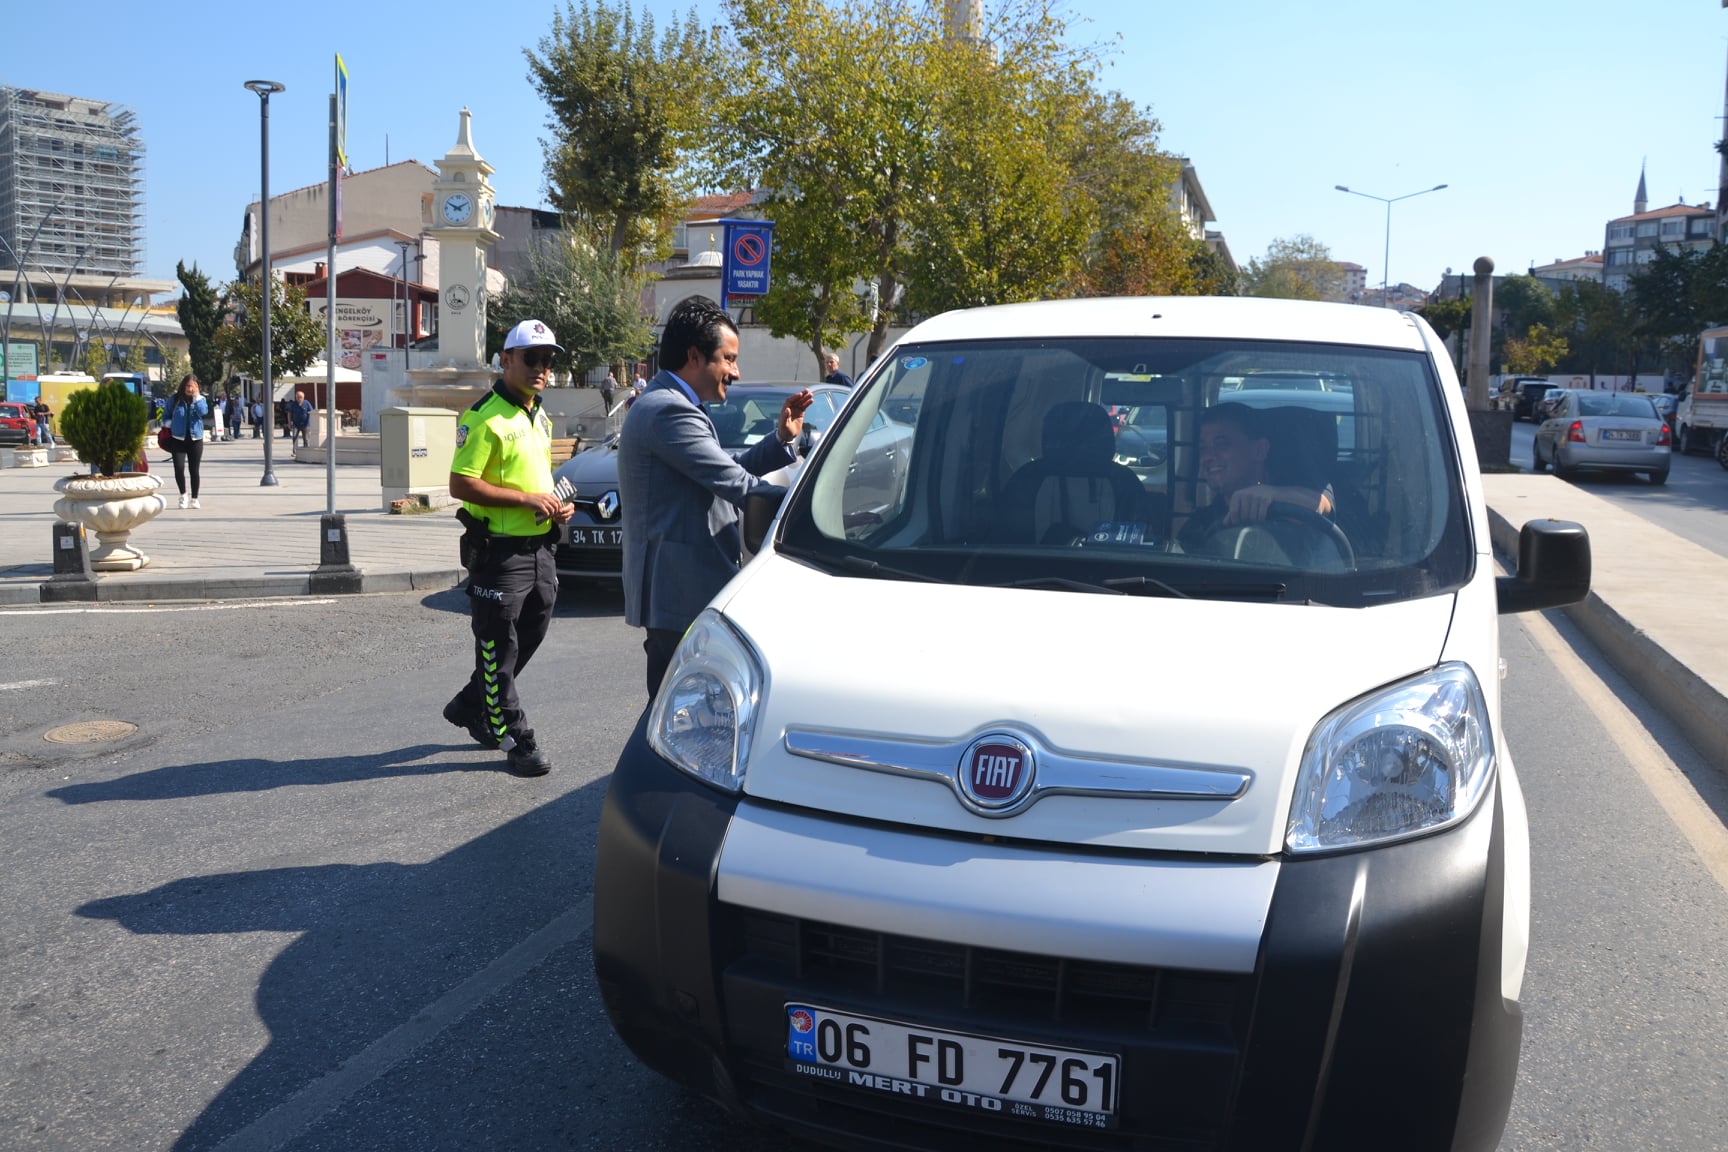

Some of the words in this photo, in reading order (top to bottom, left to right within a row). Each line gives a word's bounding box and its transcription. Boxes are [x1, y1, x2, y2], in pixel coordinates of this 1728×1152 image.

[335, 307, 372, 315] ENGELKÖY
[573, 530, 586, 544] 34
[591, 530, 605, 544] TK
[975, 754, 1020, 788] FIAT
[793, 1040, 814, 1056] TR
[817, 1018, 871, 1069] 06
[908, 1033, 964, 1086] FD
[998, 1048, 1112, 1111] 7761
[796, 1064, 841, 1080] DUDULLU
[849, 1071, 931, 1098] MERT
[940, 1089, 1002, 1111] OTO
[1044, 1107, 1064, 1115] 0507
